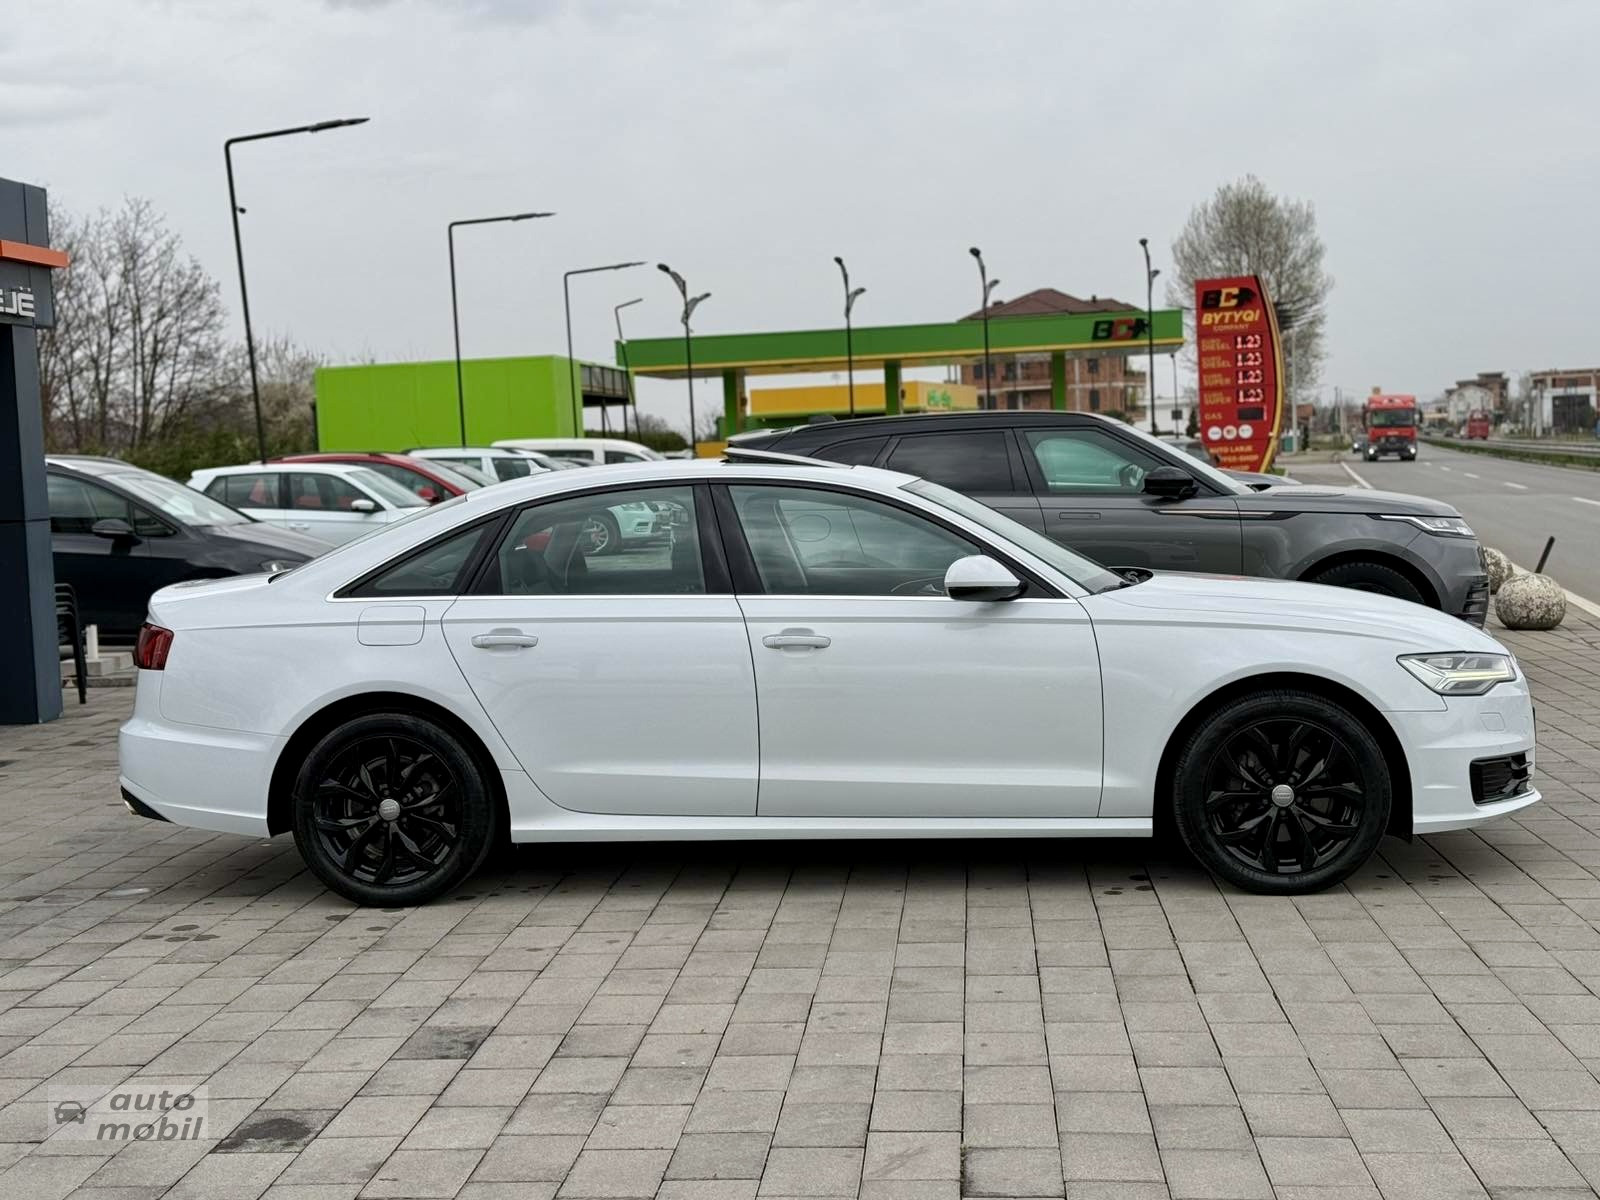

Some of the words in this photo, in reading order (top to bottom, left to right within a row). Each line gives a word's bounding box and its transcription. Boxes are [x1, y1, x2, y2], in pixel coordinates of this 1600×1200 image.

[0, 286, 36, 317] JË
[1202, 310, 1260, 325] BYTYQI
[1236, 334, 1261, 349] 1.23
[1237, 352, 1262, 367] 1.23
[1238, 370, 1263, 385] 1.23
[1238, 388, 1264, 403] 1.23
